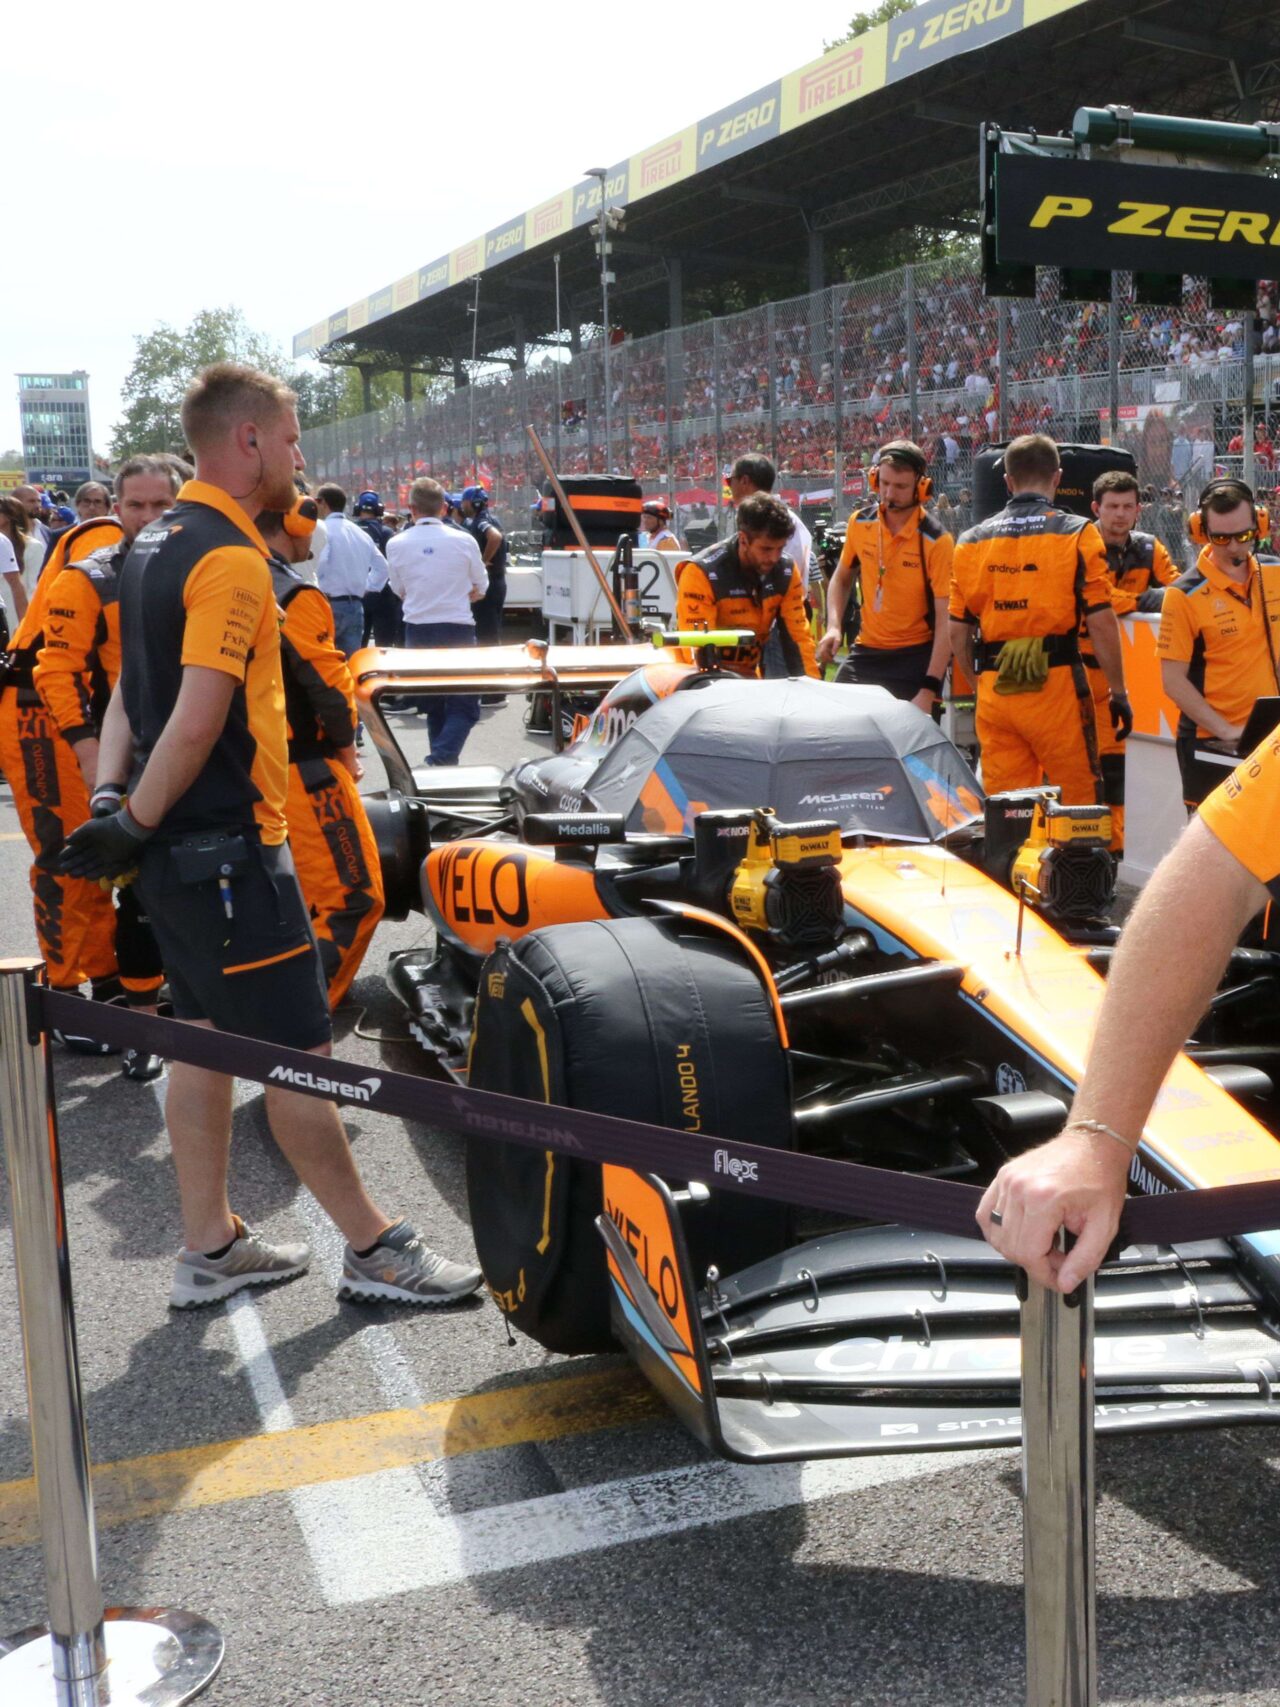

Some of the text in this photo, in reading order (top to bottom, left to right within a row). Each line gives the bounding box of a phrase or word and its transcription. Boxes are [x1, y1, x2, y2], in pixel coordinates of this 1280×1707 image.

[892, 28, 916, 63] P
[799, 47, 863, 113] PIRELLI
[700, 99, 776, 155] P ZERO
[640, 138, 682, 188] PIRELLI
[575, 193, 586, 214] P
[1029, 195, 1093, 228] P
[1056, 488, 1078, 496] ANDO
[637, 561, 660, 599] 2
[798, 791, 884, 804] McLaren
[558, 824, 610, 836] Medallia
[438, 847, 530, 928] VELO
[268, 1065, 370, 1101] McLaren
[676, 1044, 701, 1131] LANDO 4
[714, 1148, 759, 1183] flex
